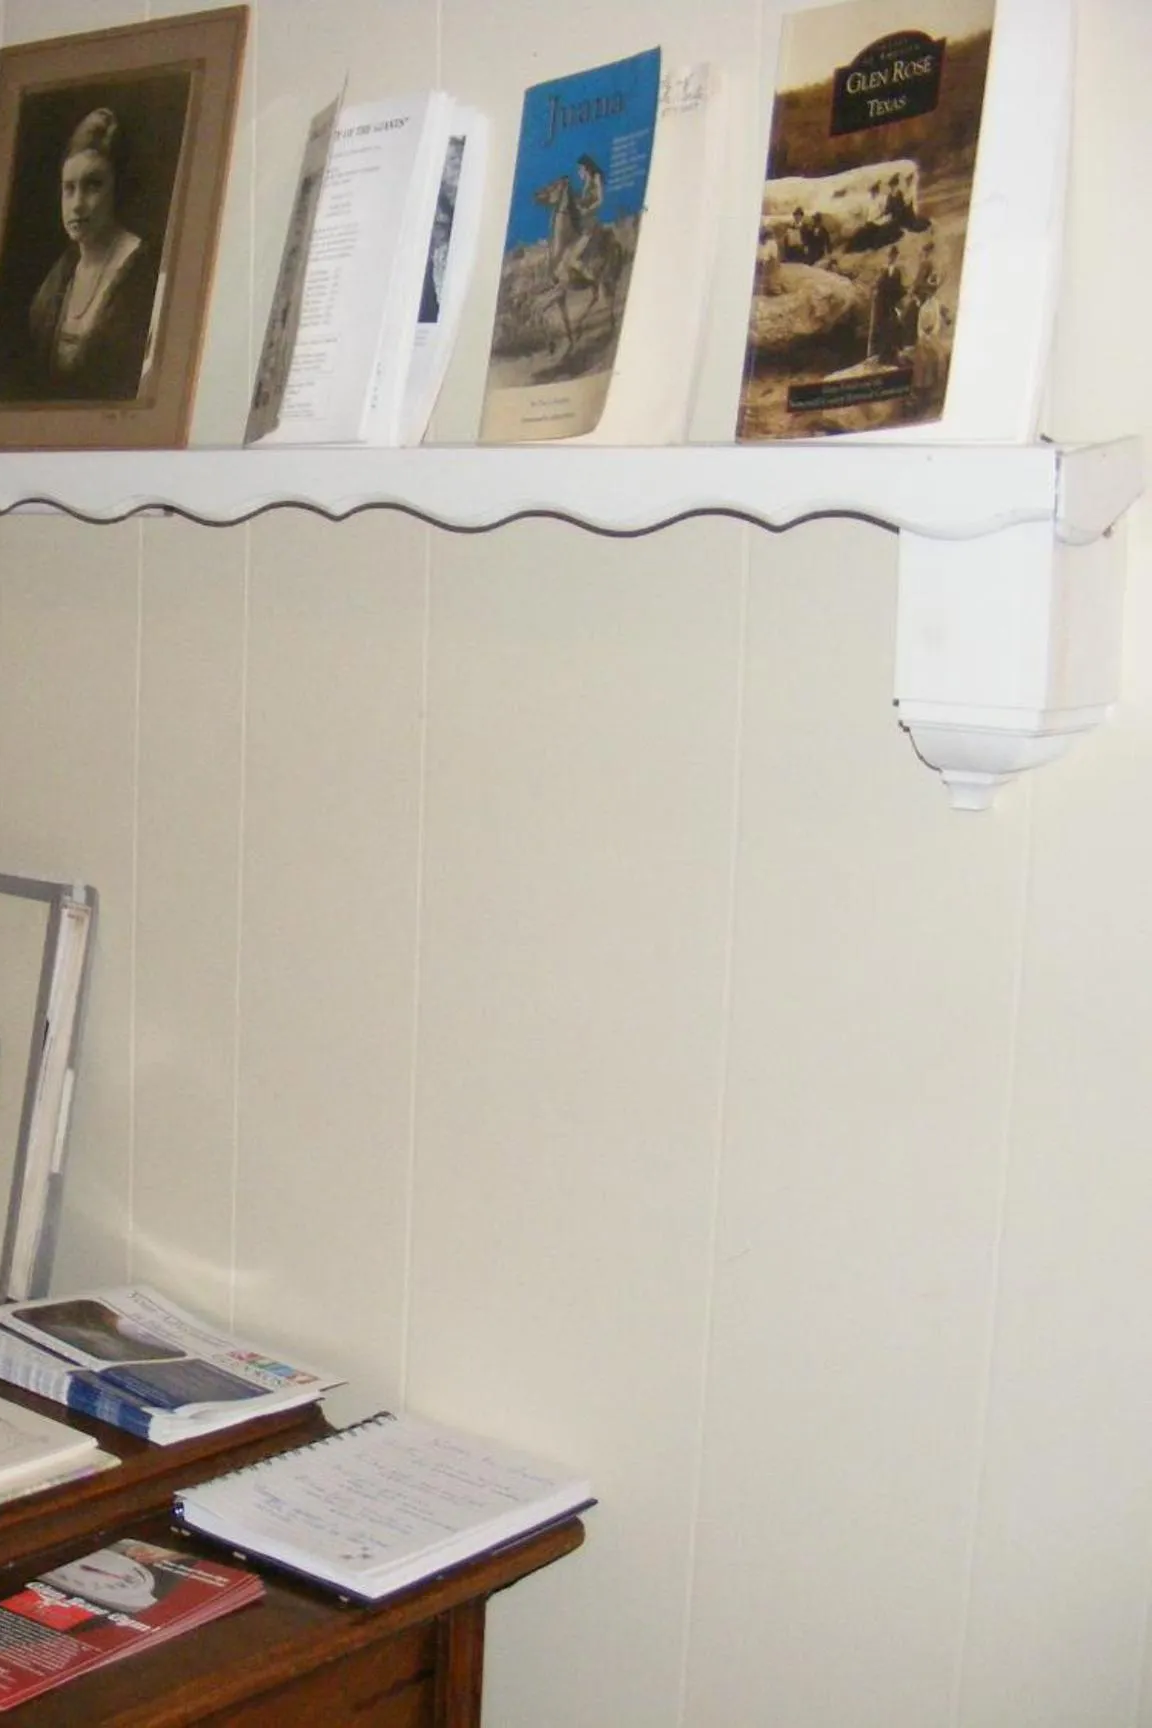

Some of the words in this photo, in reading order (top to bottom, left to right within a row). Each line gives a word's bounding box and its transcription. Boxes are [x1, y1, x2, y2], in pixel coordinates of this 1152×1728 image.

[846, 69, 889, 93] GLEN
[892, 55, 934, 82] ROSE
[868, 96, 907, 118] TEXAS
